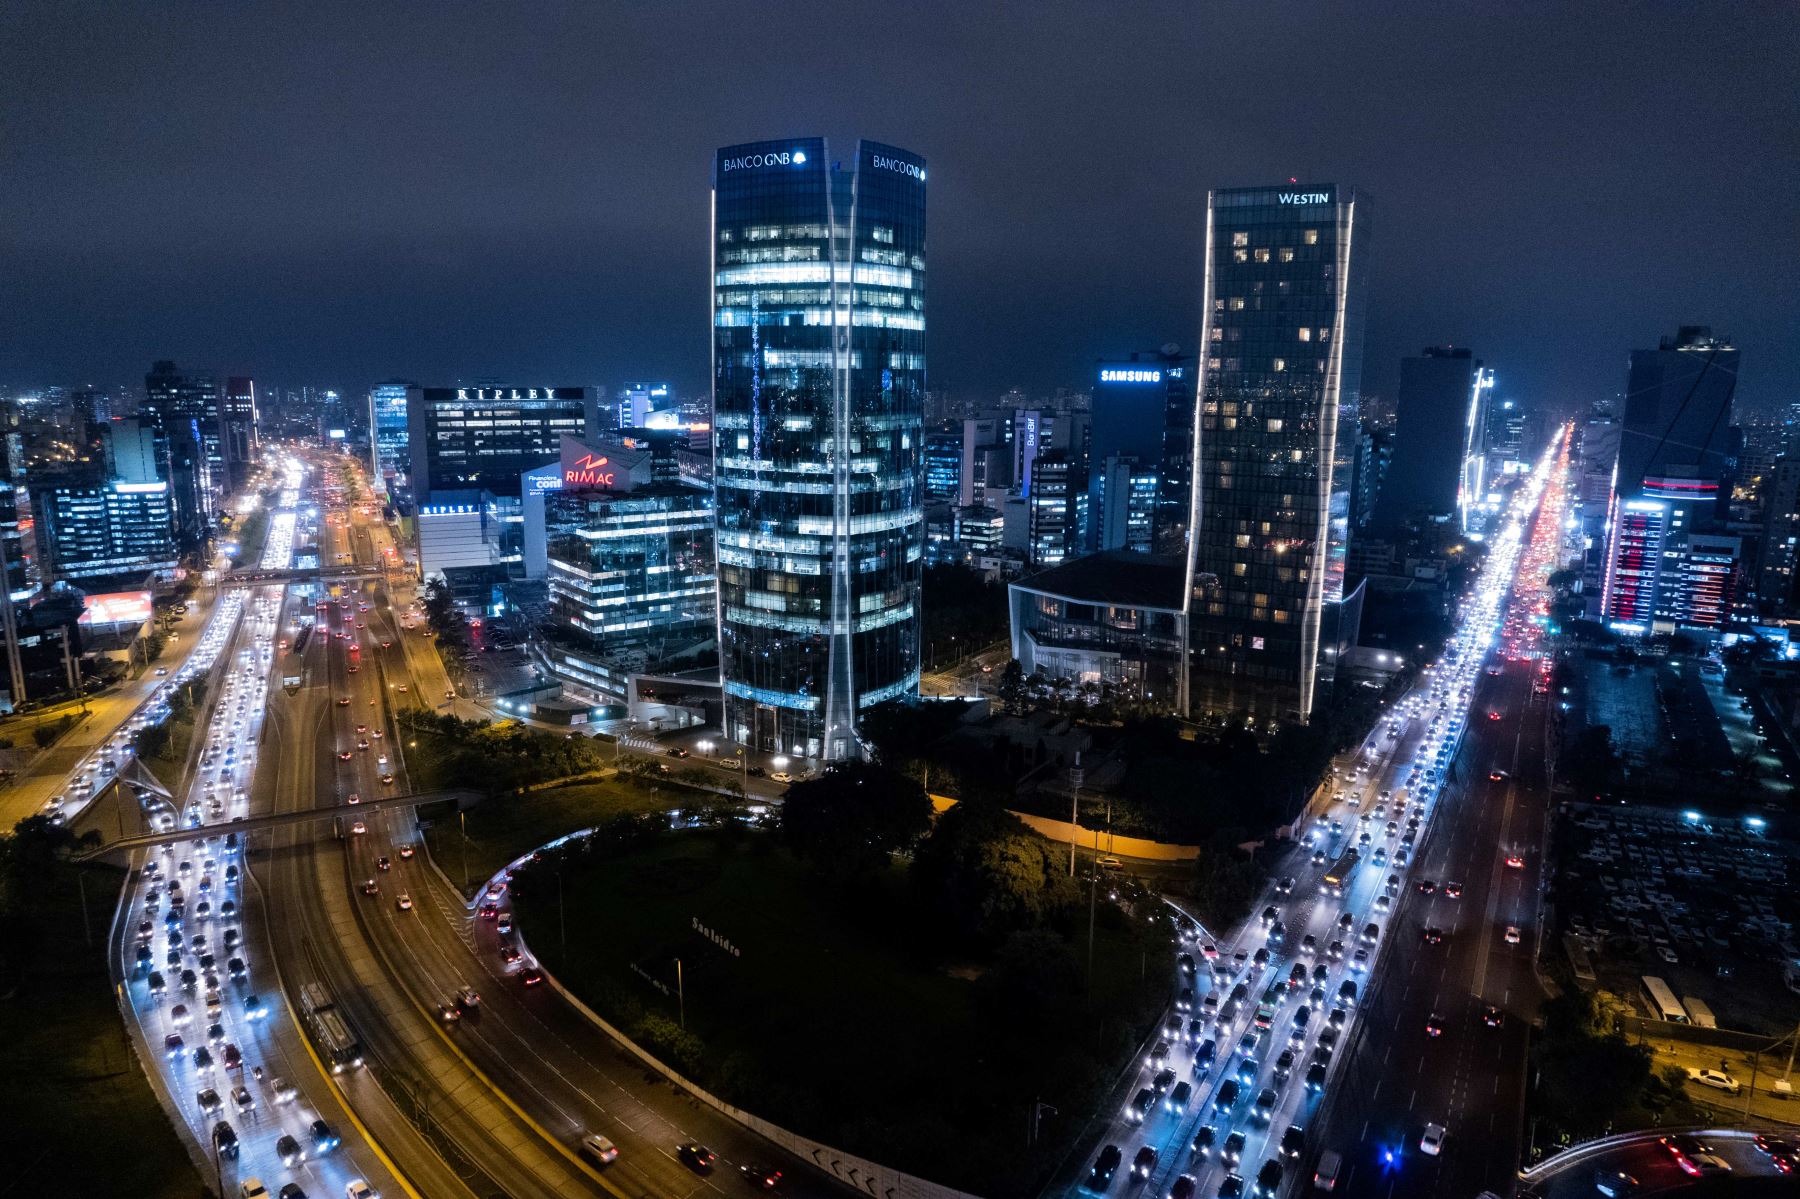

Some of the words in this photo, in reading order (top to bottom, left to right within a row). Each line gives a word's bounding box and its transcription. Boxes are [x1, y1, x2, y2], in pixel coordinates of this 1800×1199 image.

[724, 154, 763, 172] BANCO
[764, 152, 790, 166] GNB
[873, 155, 906, 174] BANCO
[906, 163, 920, 179] GNB
[1279, 193, 1329, 205] WESTIN
[1101, 370, 1161, 382] SAMSUNG
[457, 388, 556, 400] RIPLEY
[566, 470, 614, 485] RIMAC
[423, 504, 474, 514] RIPLEY
[692, 916, 710, 938] San
[710, 928, 741, 957] Isidro
